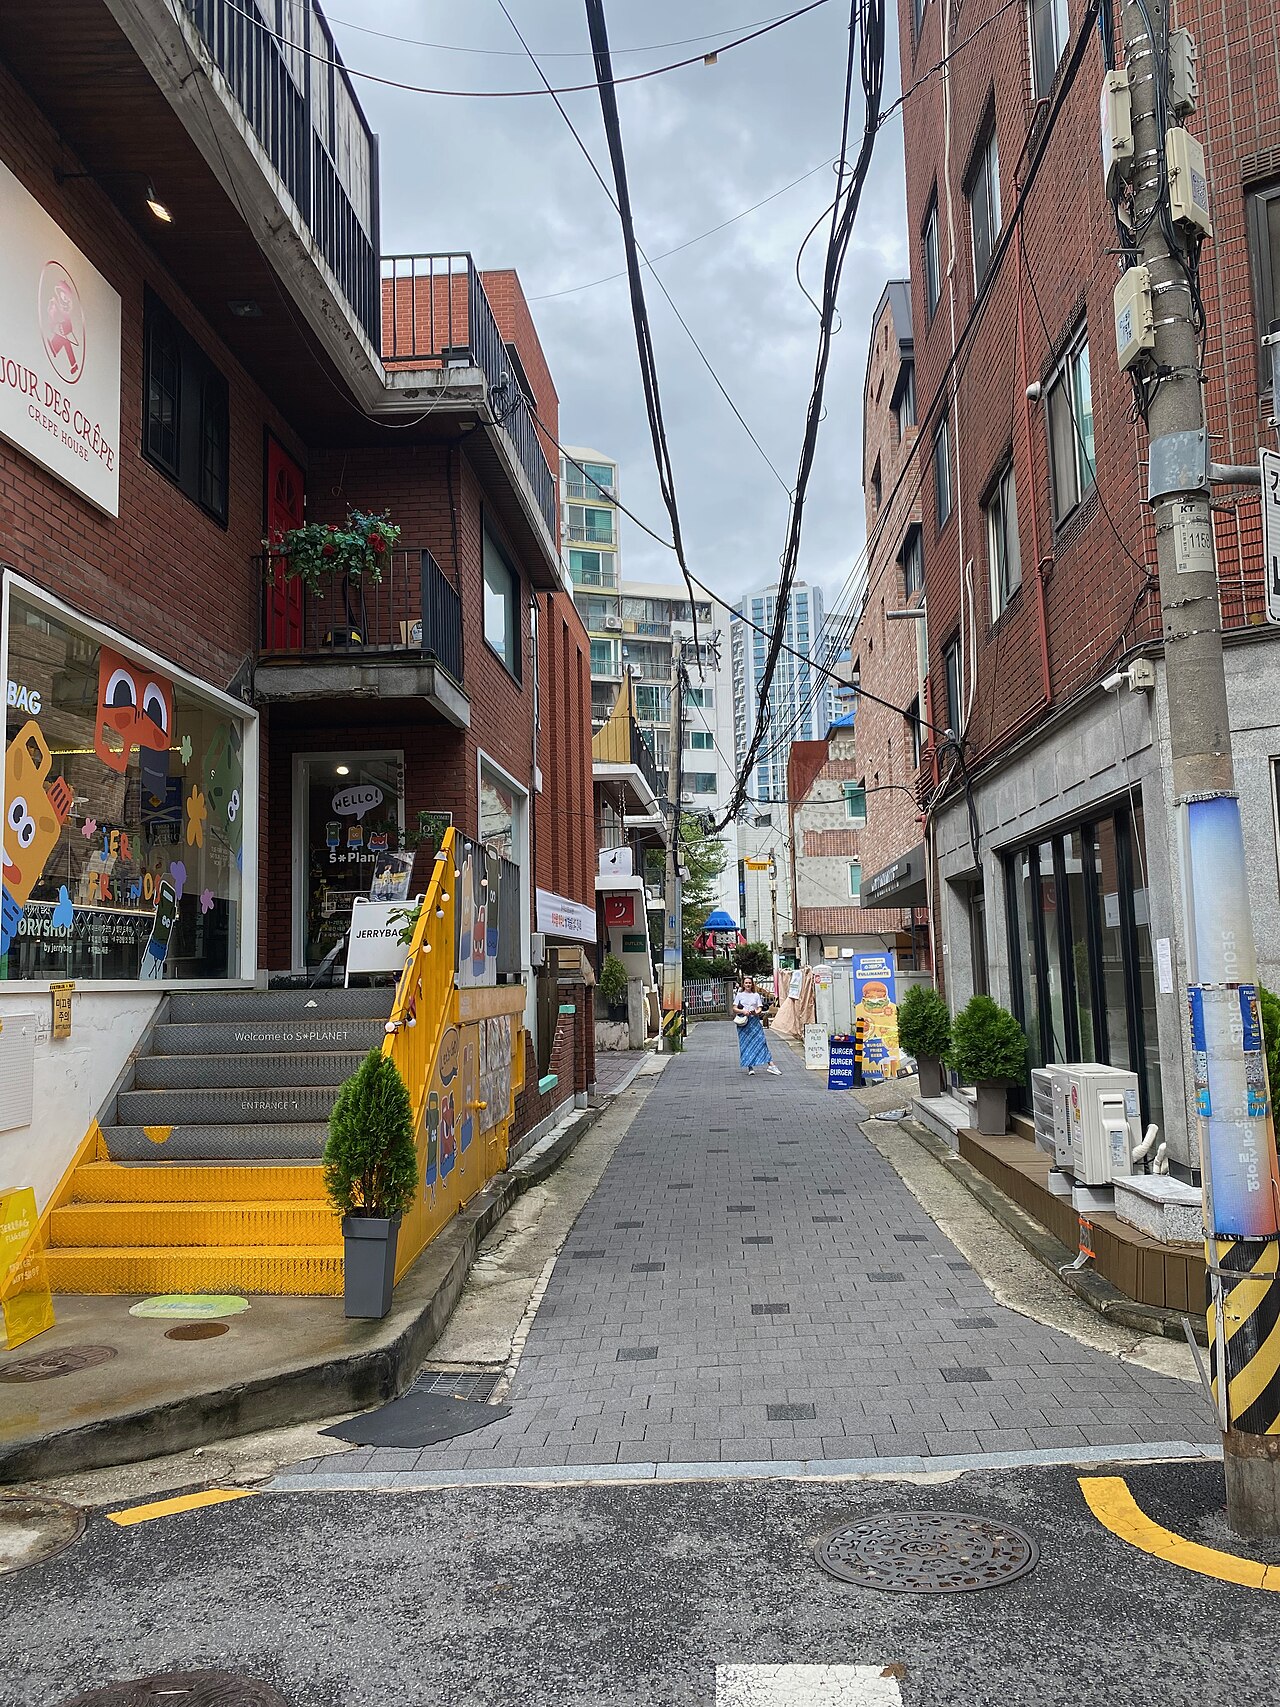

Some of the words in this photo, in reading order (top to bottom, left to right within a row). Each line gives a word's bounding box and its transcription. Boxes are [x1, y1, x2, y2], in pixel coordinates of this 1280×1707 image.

[44, 382, 71, 424] DES
[73, 410, 115, 472] CRÊPE
[28, 404, 58, 438] CREPE
[61, 430, 89, 462] HOUSE
[1181, 504, 1196, 513] KT
[7, 680, 42, 715] BAG
[334, 789, 379, 811] HELLO!
[234, 1032, 281, 1041] Welcome
[283, 1032, 294, 1041] to
[830, 1058, 853, 1066] BURGER
[829, 1068, 853, 1076] BURGER
[241, 1101, 289, 1110] ENTRANCE
